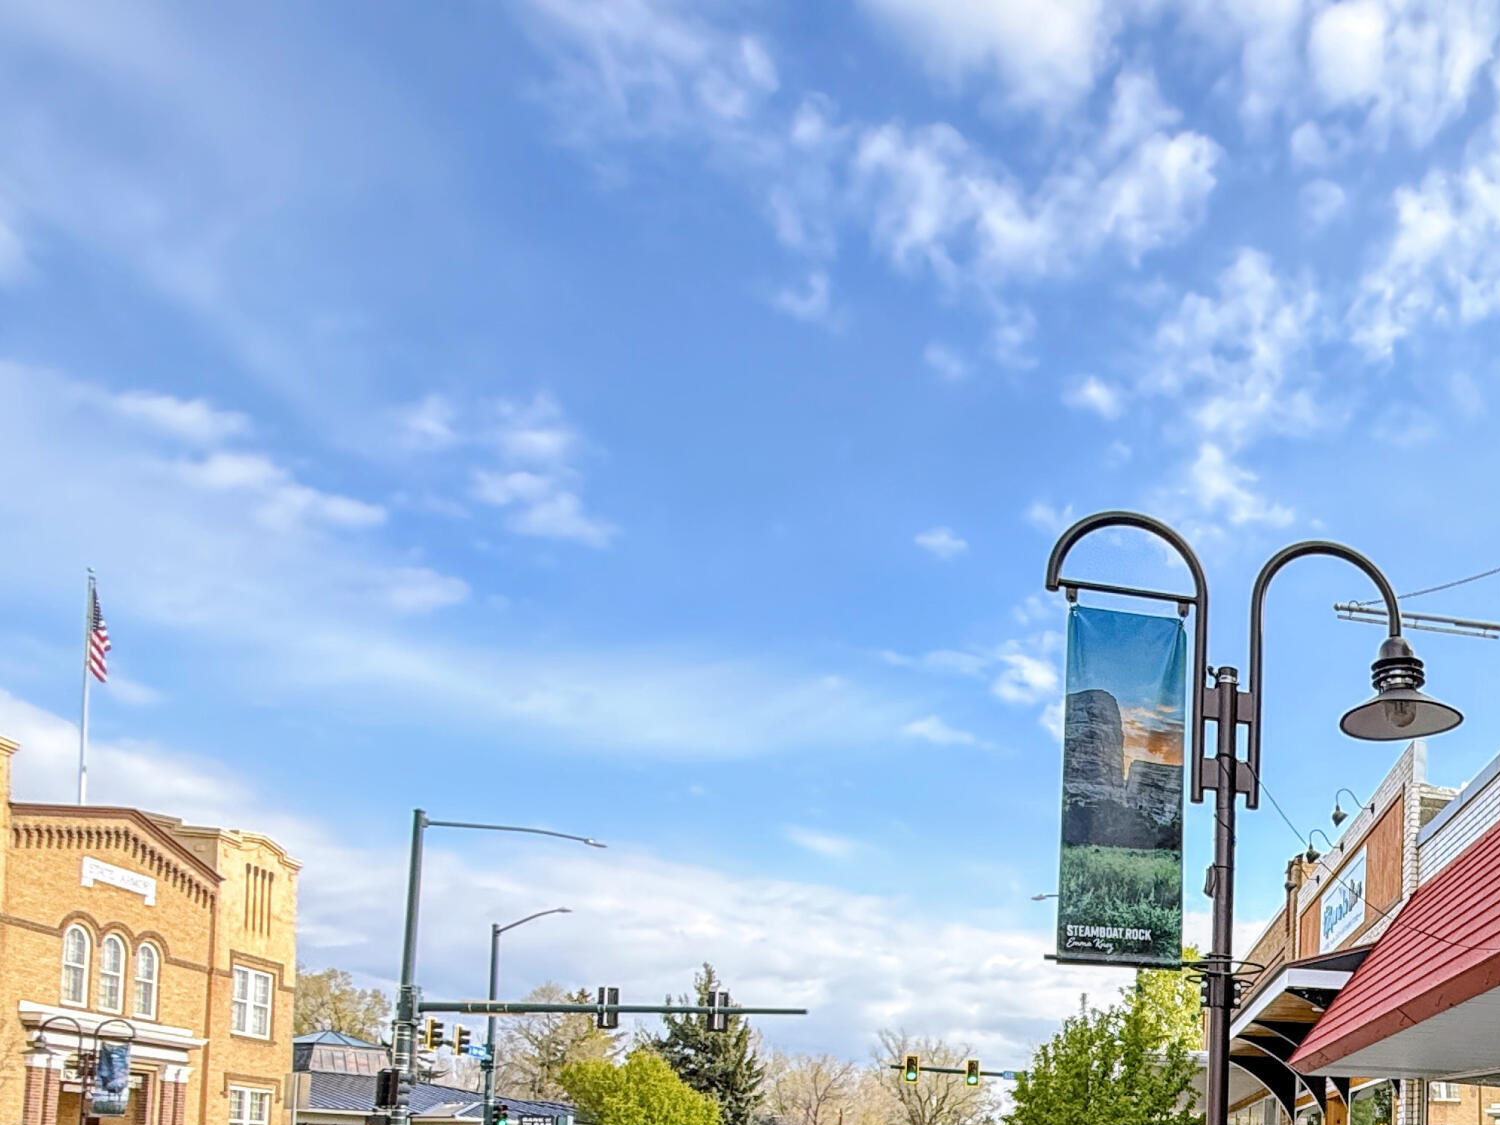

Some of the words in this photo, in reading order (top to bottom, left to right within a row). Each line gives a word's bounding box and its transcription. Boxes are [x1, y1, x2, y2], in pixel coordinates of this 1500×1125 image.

[1066, 925, 1123, 939] STEAMBOAT
[1125, 929, 1152, 941] ROCK
[1066, 937, 1093, 948] Emma
